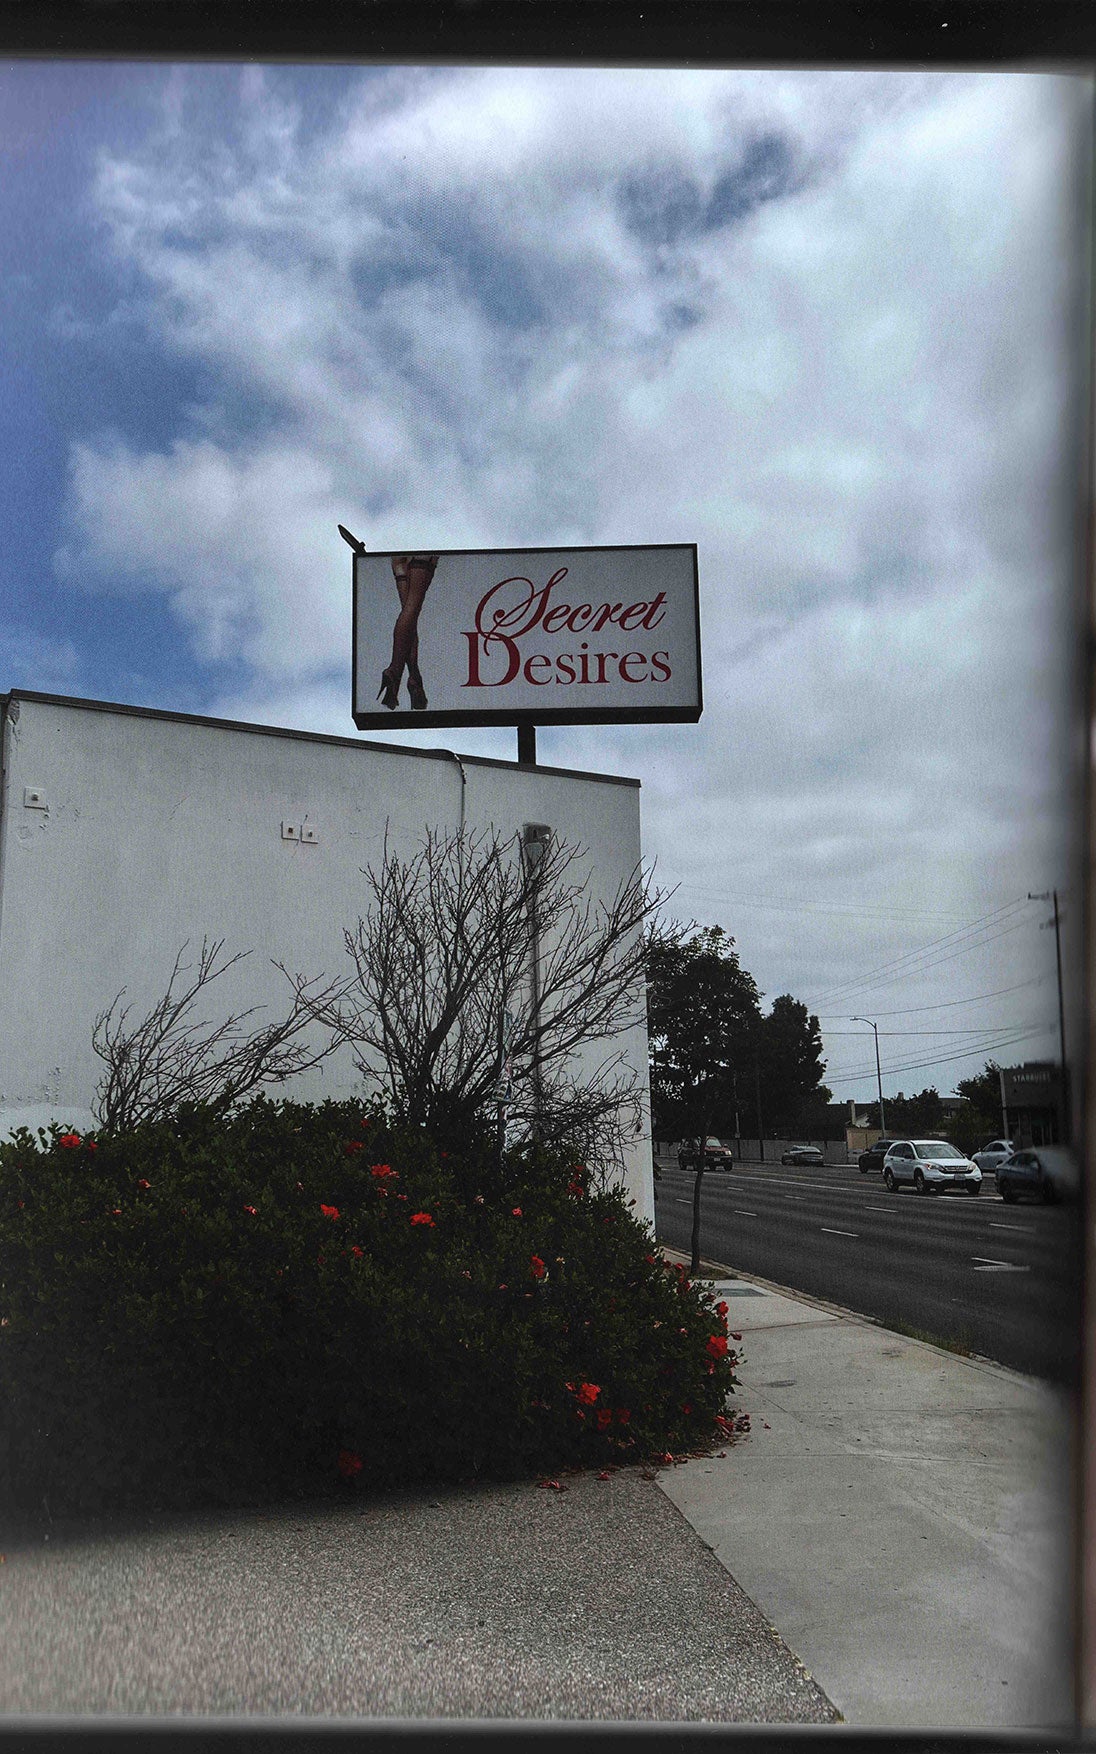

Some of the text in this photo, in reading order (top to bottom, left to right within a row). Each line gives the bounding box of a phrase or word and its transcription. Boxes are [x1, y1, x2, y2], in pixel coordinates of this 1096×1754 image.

[474, 567, 668, 657] Secret
[460, 631, 672, 687] Desires
[1012, 1072, 1051, 1084] STARBU
